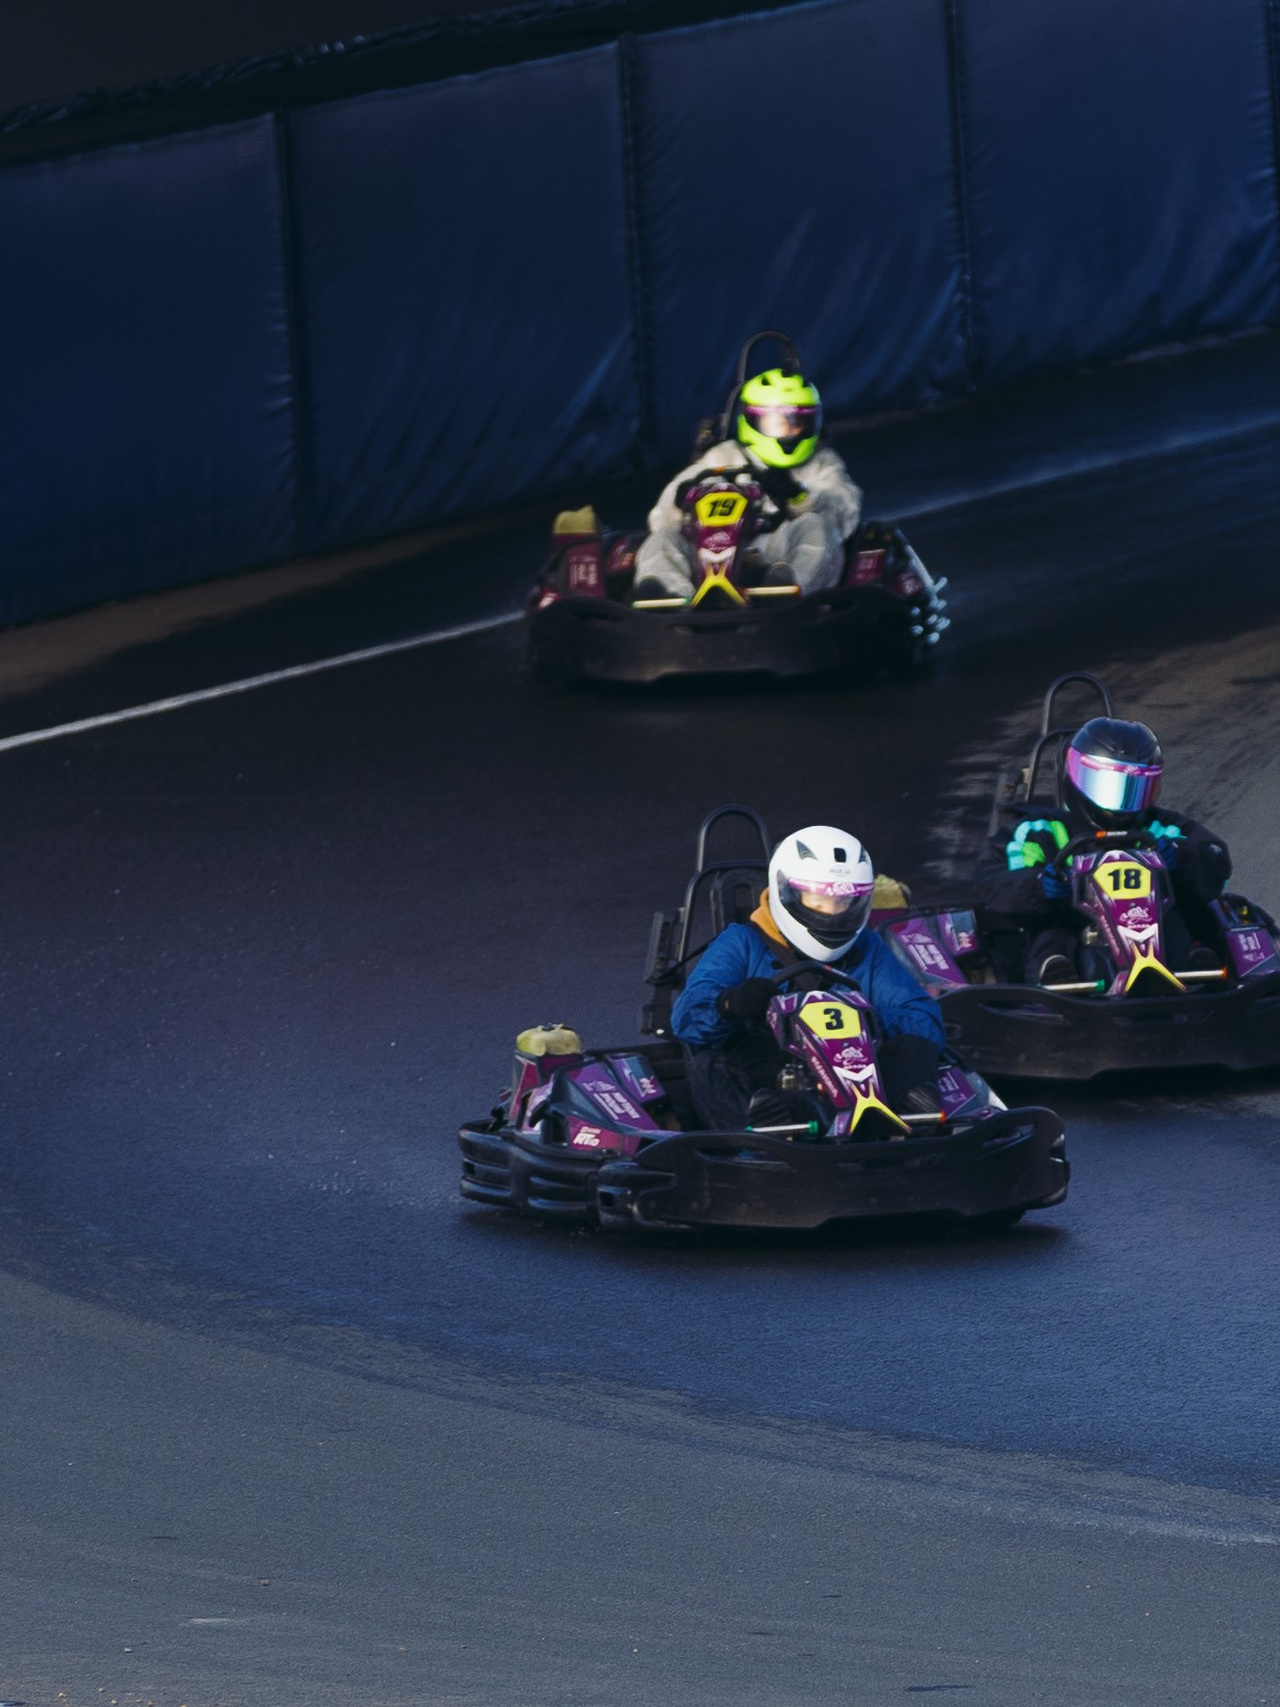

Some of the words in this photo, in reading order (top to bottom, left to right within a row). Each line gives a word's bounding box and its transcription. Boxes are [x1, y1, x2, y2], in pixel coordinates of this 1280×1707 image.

[708, 498, 737, 517] 19
[1108, 869, 1141, 891] 18
[823, 1008, 844, 1031] 3
